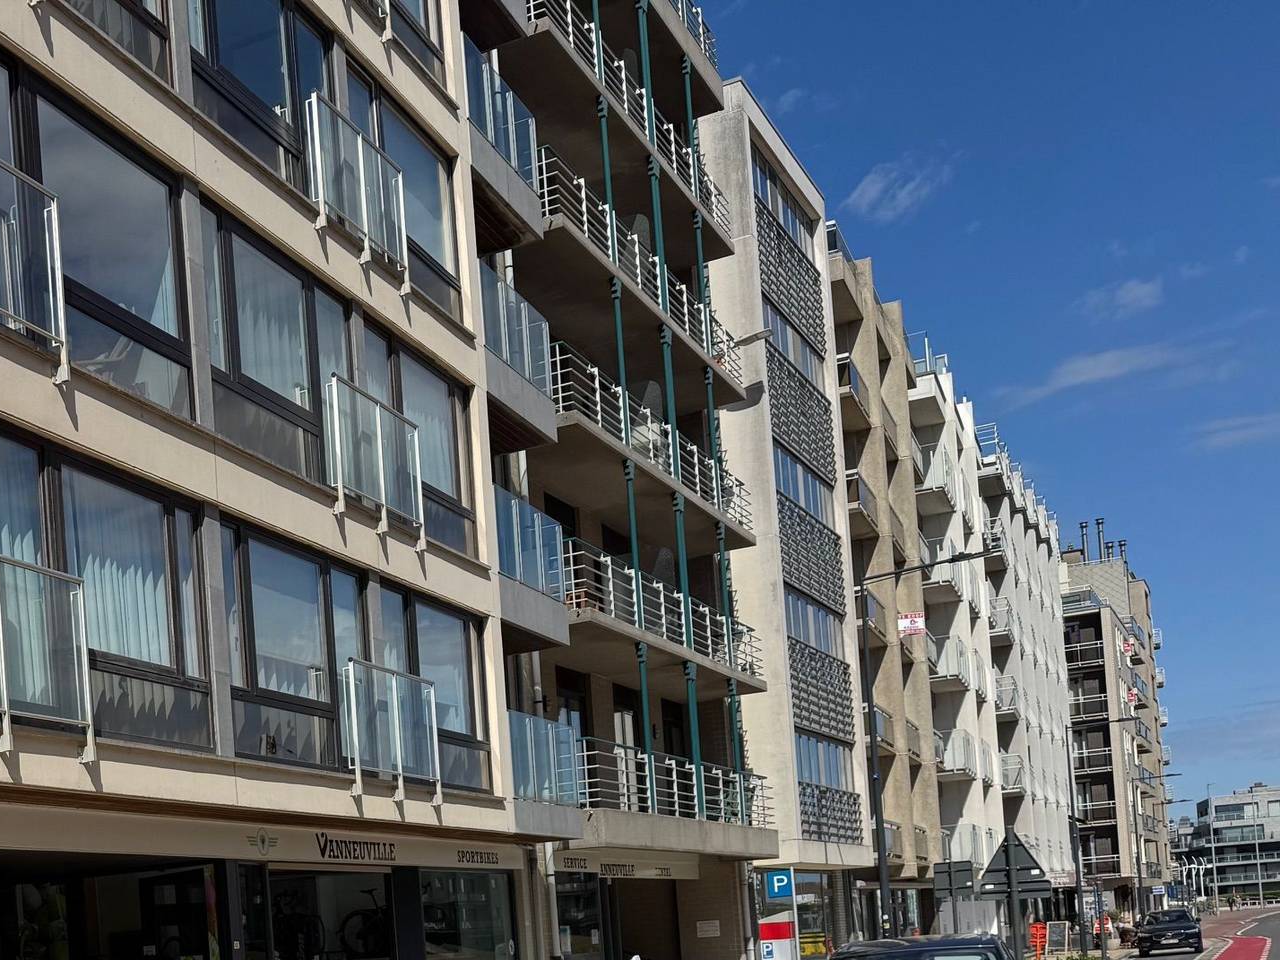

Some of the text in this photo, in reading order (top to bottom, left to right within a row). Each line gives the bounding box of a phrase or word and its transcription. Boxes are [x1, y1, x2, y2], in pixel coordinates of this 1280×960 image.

[315, 832, 396, 861] VANNEUVILLE
[457, 850, 499, 864] SPORTBIKES
[563, 857, 587, 869] SERVICE
[600, 864, 635, 876] ANNEUVILLE
[773, 876, 788, 893] P
[763, 944, 773, 956] P
